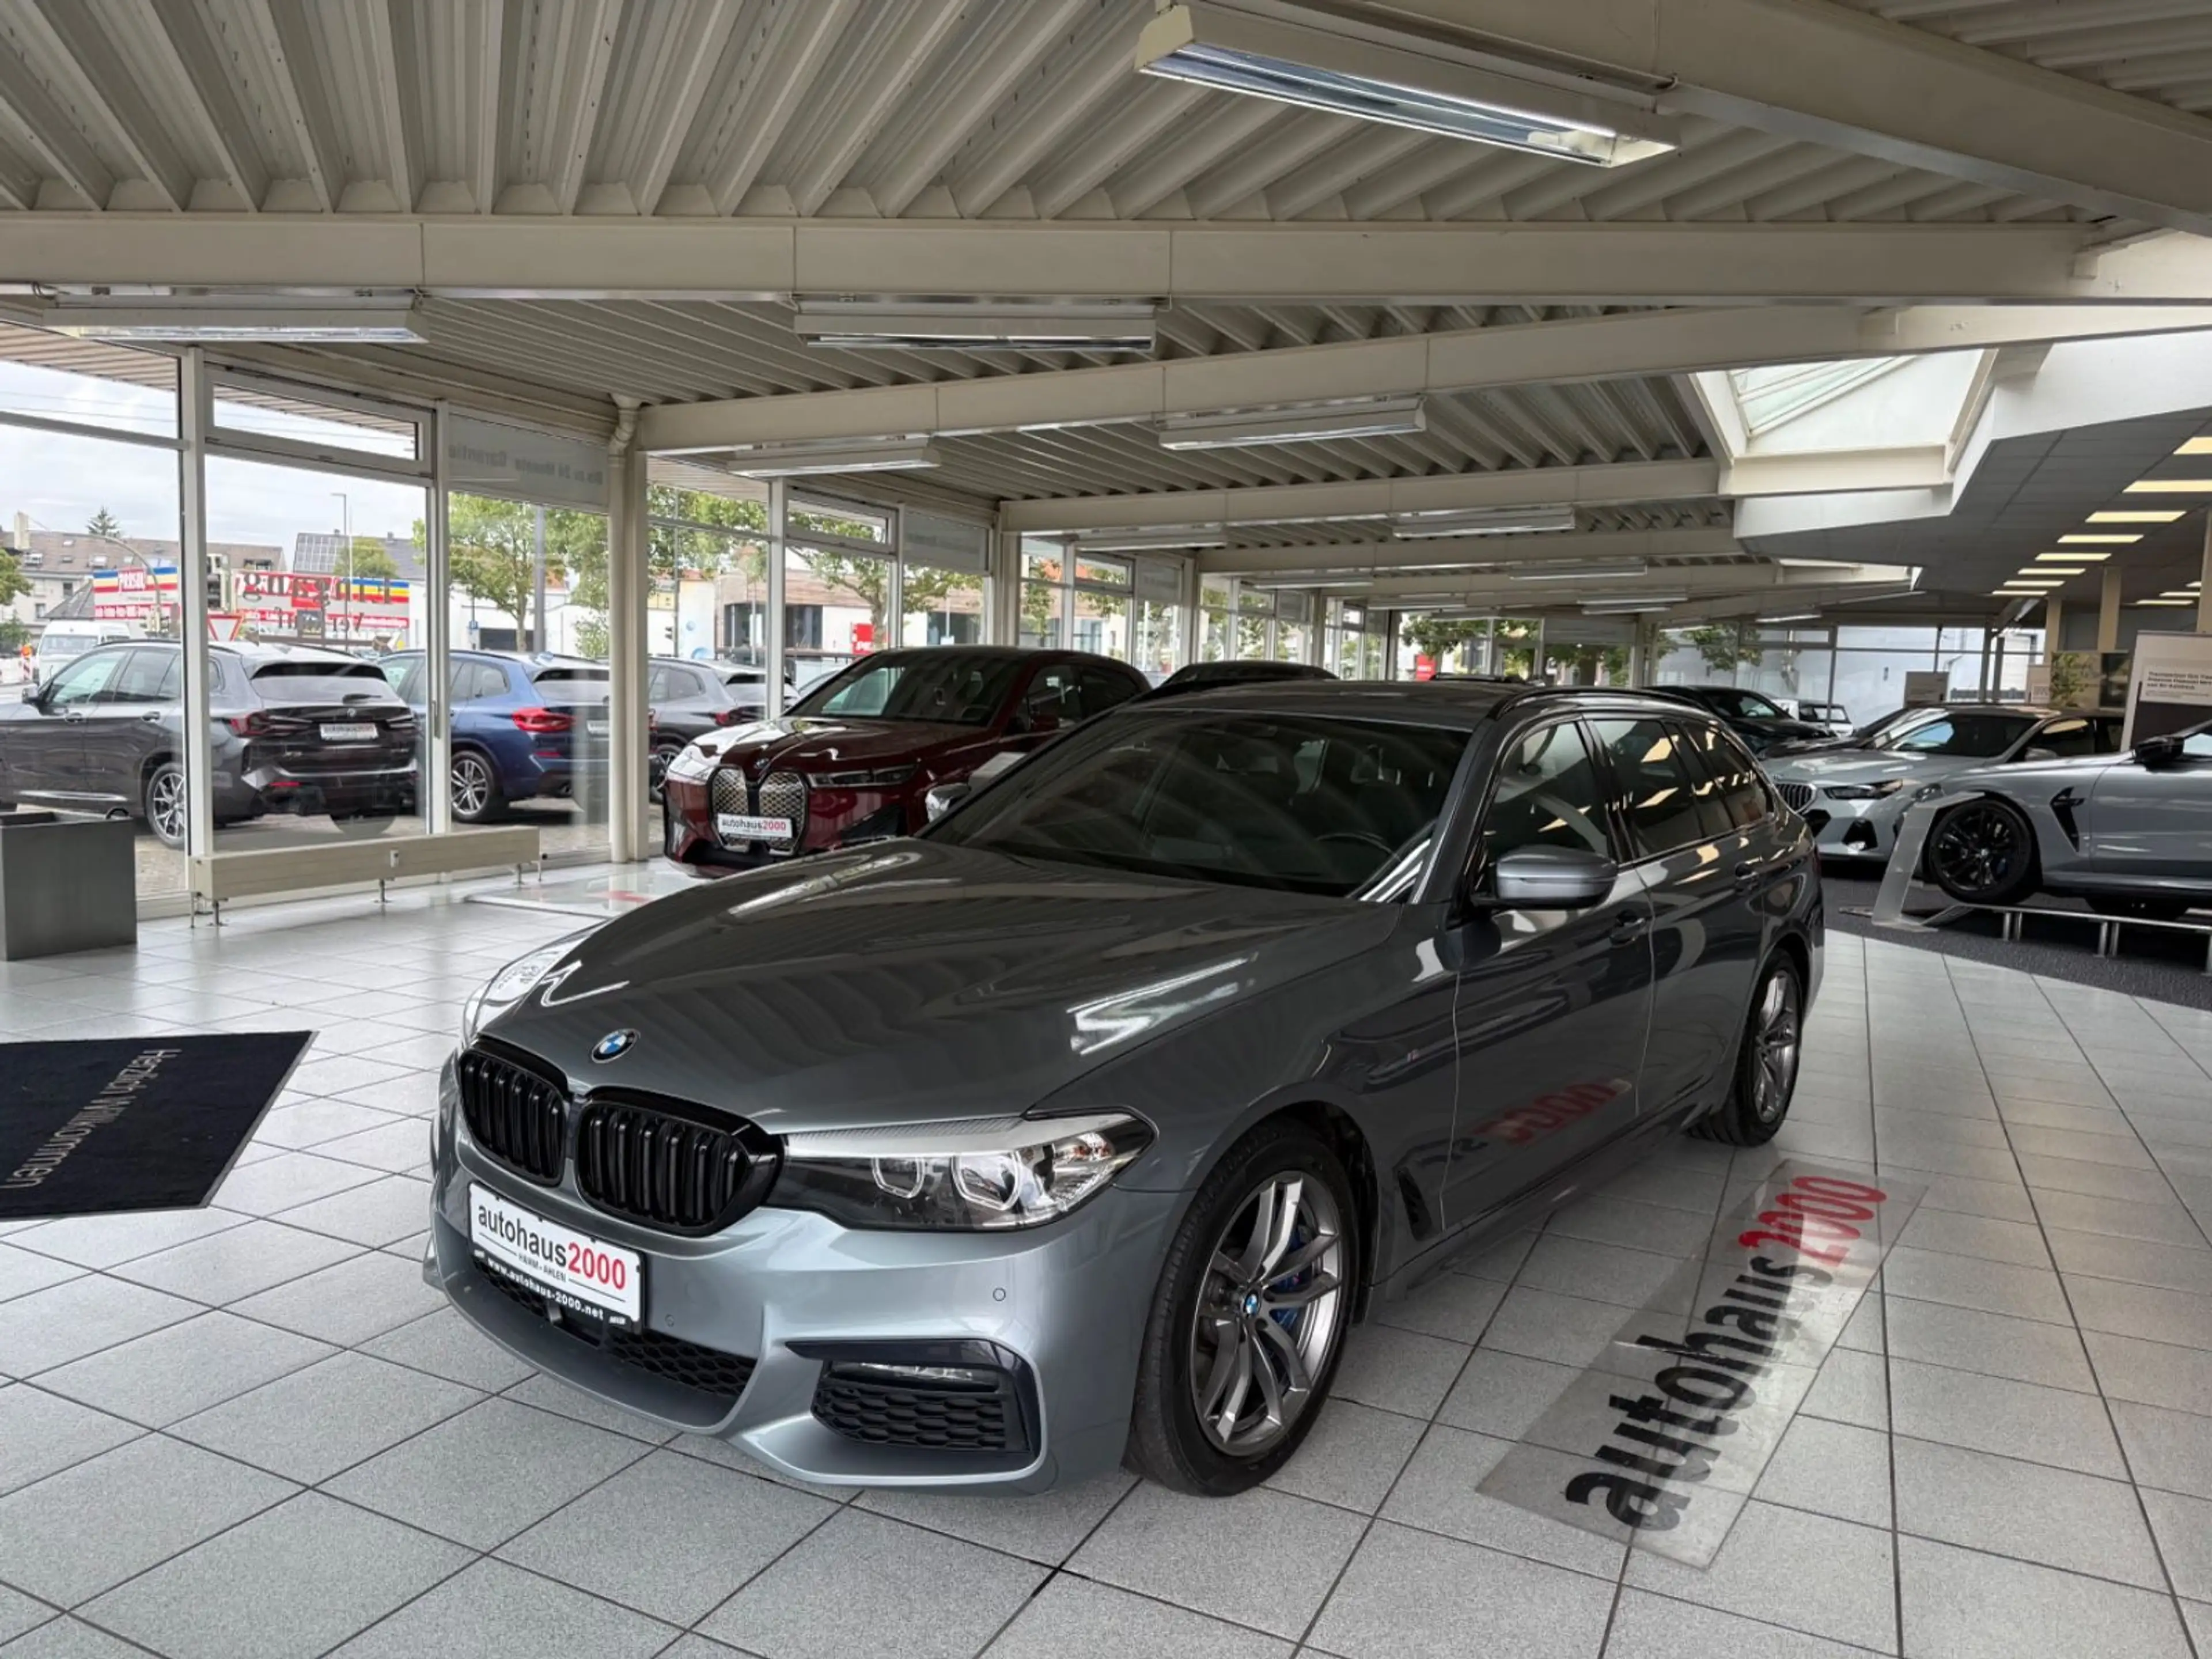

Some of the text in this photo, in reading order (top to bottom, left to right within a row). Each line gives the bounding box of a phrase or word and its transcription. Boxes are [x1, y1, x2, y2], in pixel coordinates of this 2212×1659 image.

[721, 817, 787, 832] autohaus2000
[478, 1205, 626, 1290] autohaus2000
[487, 1257, 604, 1320] www.autohaus-2000.net
[1564, 1175, 1888, 1532] autohaus2000
